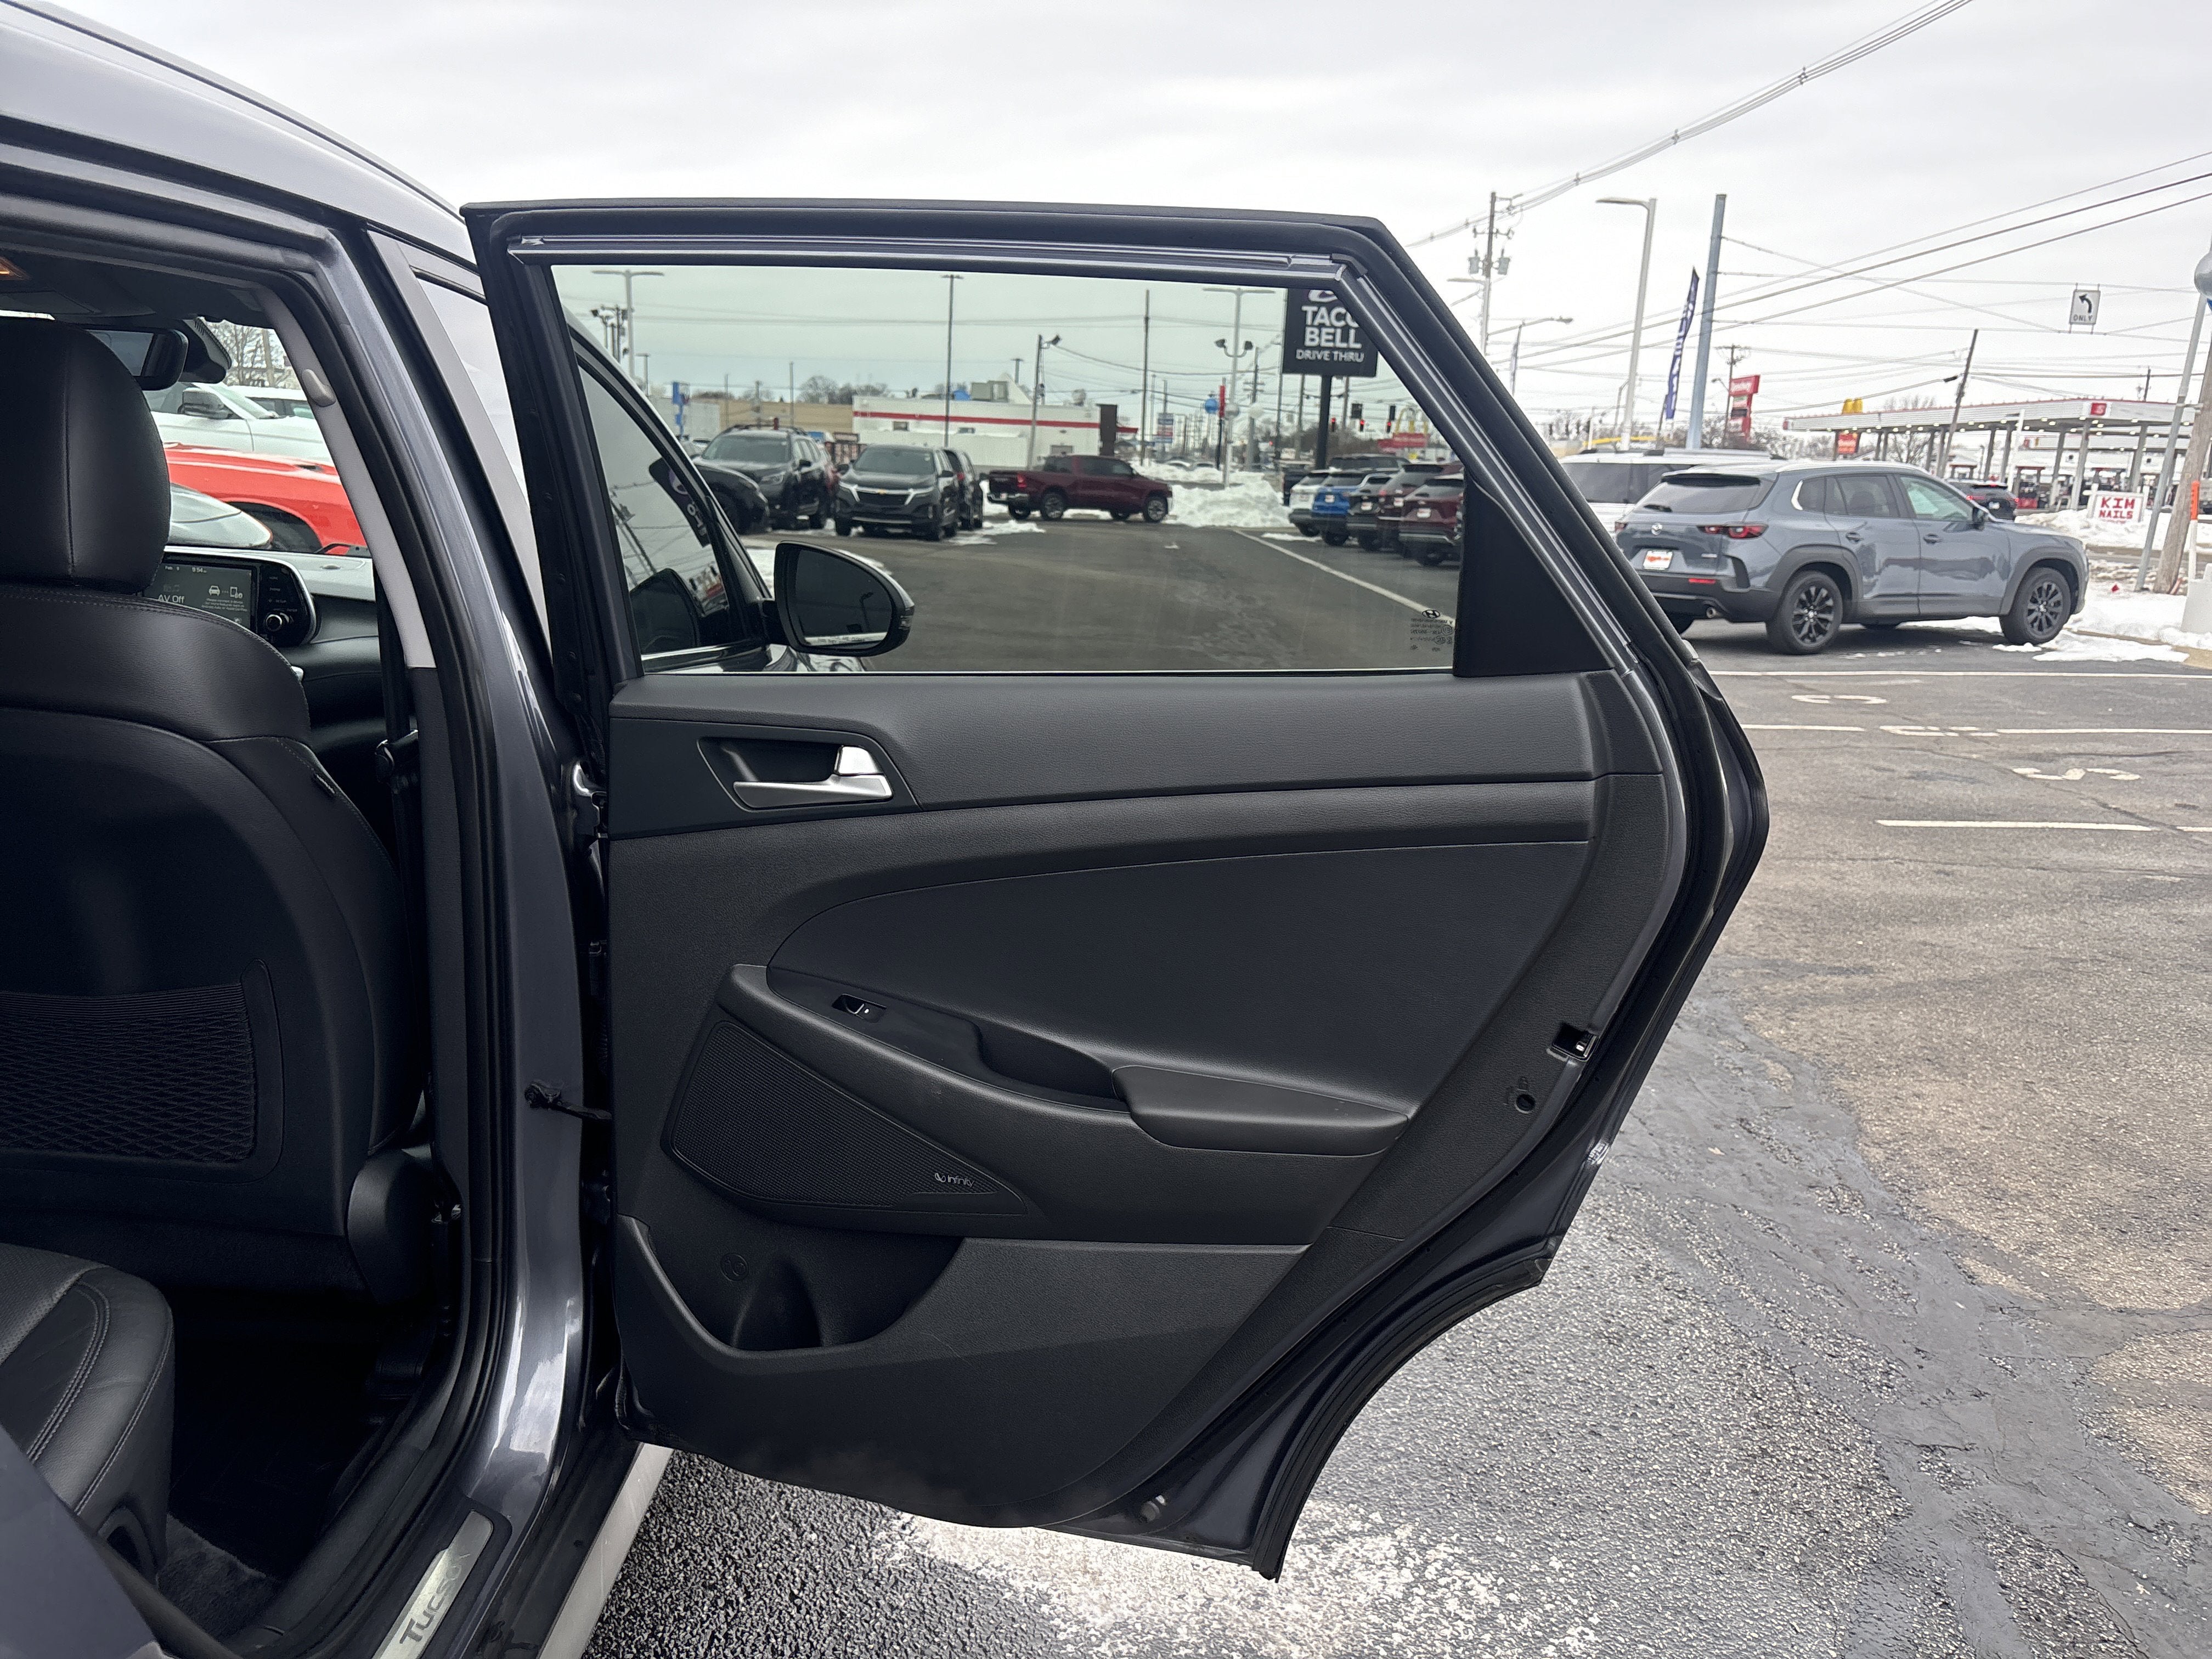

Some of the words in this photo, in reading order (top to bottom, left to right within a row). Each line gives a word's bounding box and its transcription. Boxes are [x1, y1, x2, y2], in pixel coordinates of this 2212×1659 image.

[1304, 326, 1362, 349] BELL
[1295, 349, 1330, 361] DRIVE
[1333, 350, 1364, 363] THRU
[2101, 496, 2135, 509] KIM
[2098, 510, 2134, 519] NAILS
[172, 595, 185, 604] Off
